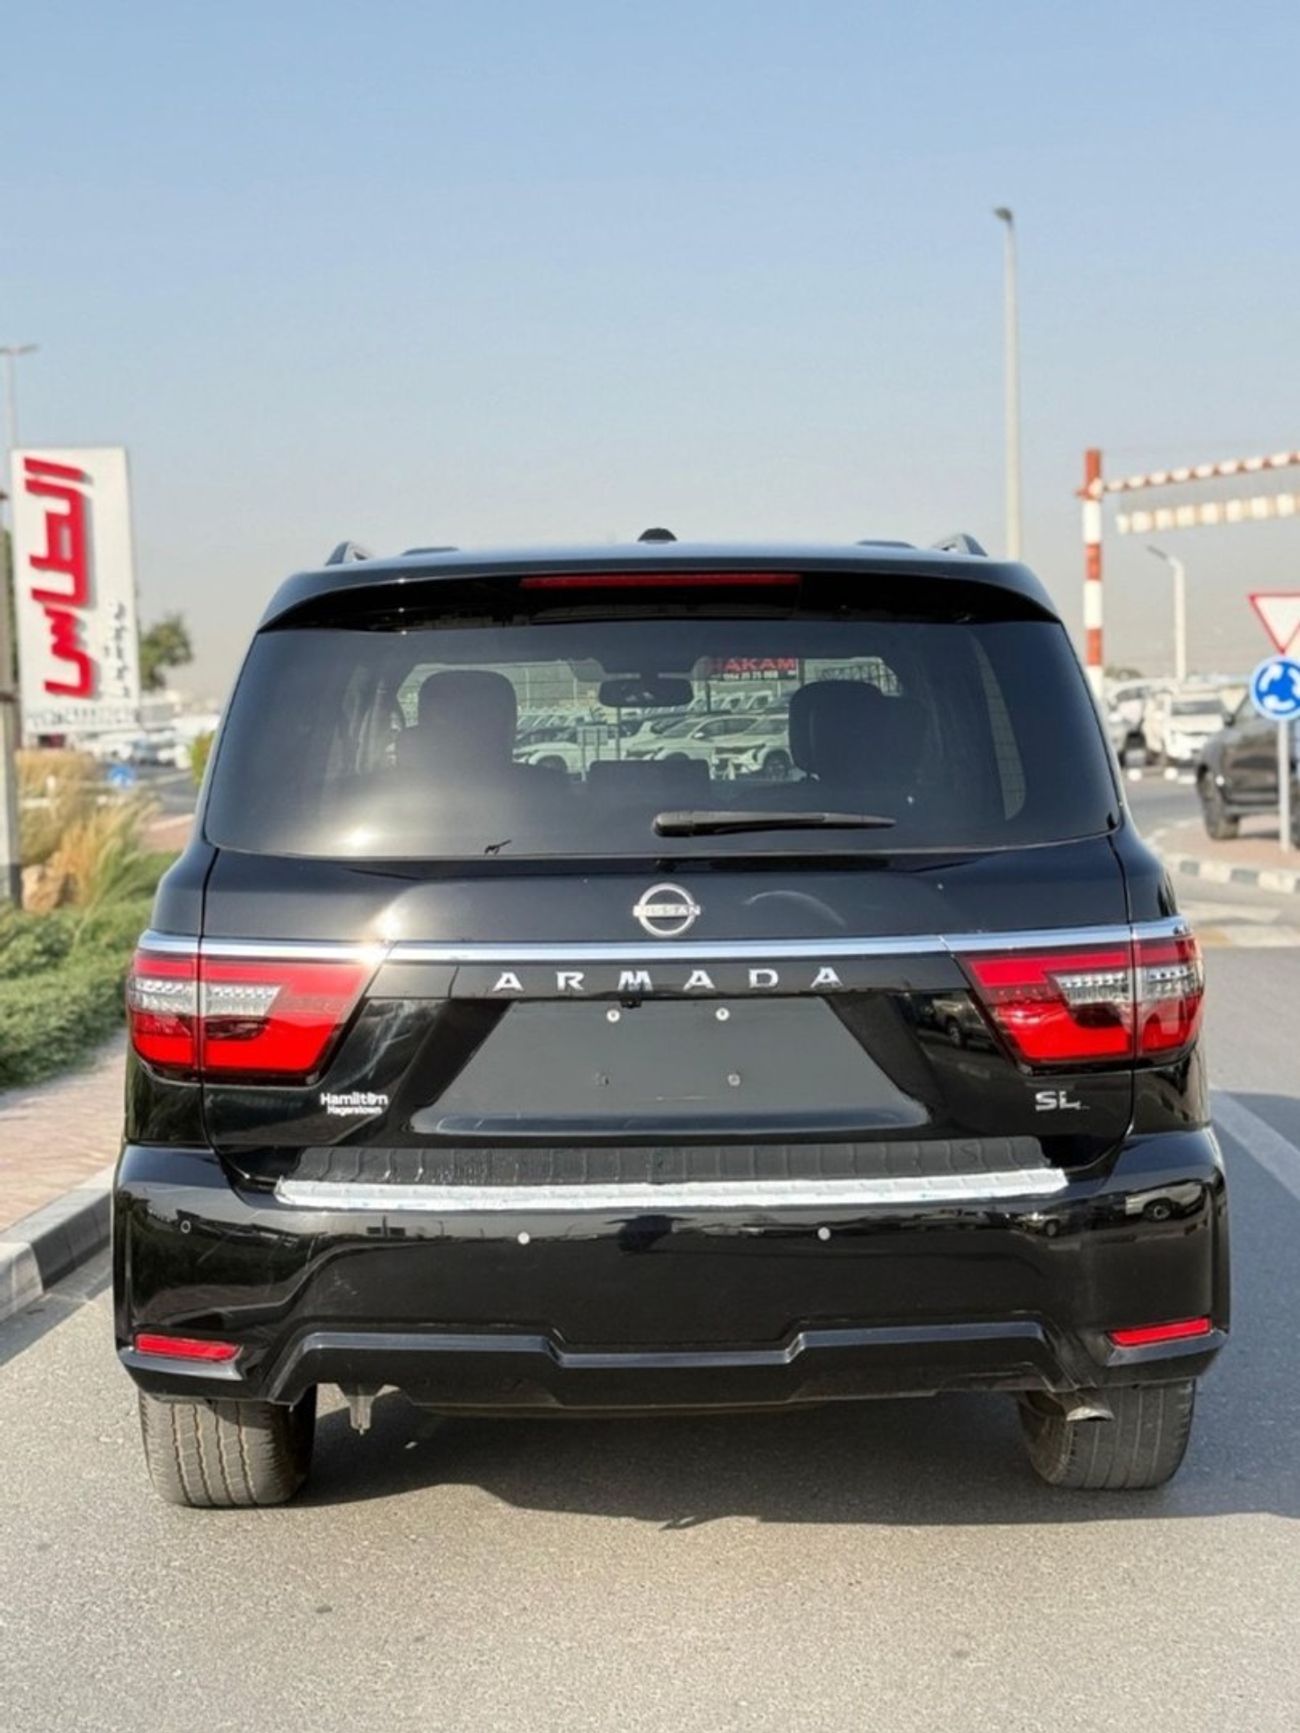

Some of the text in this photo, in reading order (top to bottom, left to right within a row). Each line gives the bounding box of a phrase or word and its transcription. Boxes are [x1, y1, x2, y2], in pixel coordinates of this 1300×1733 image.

[493, 967, 844, 991] ARMADA
[320, 1091, 389, 1106] Hamilton
[1035, 1090, 1081, 1111] SL
